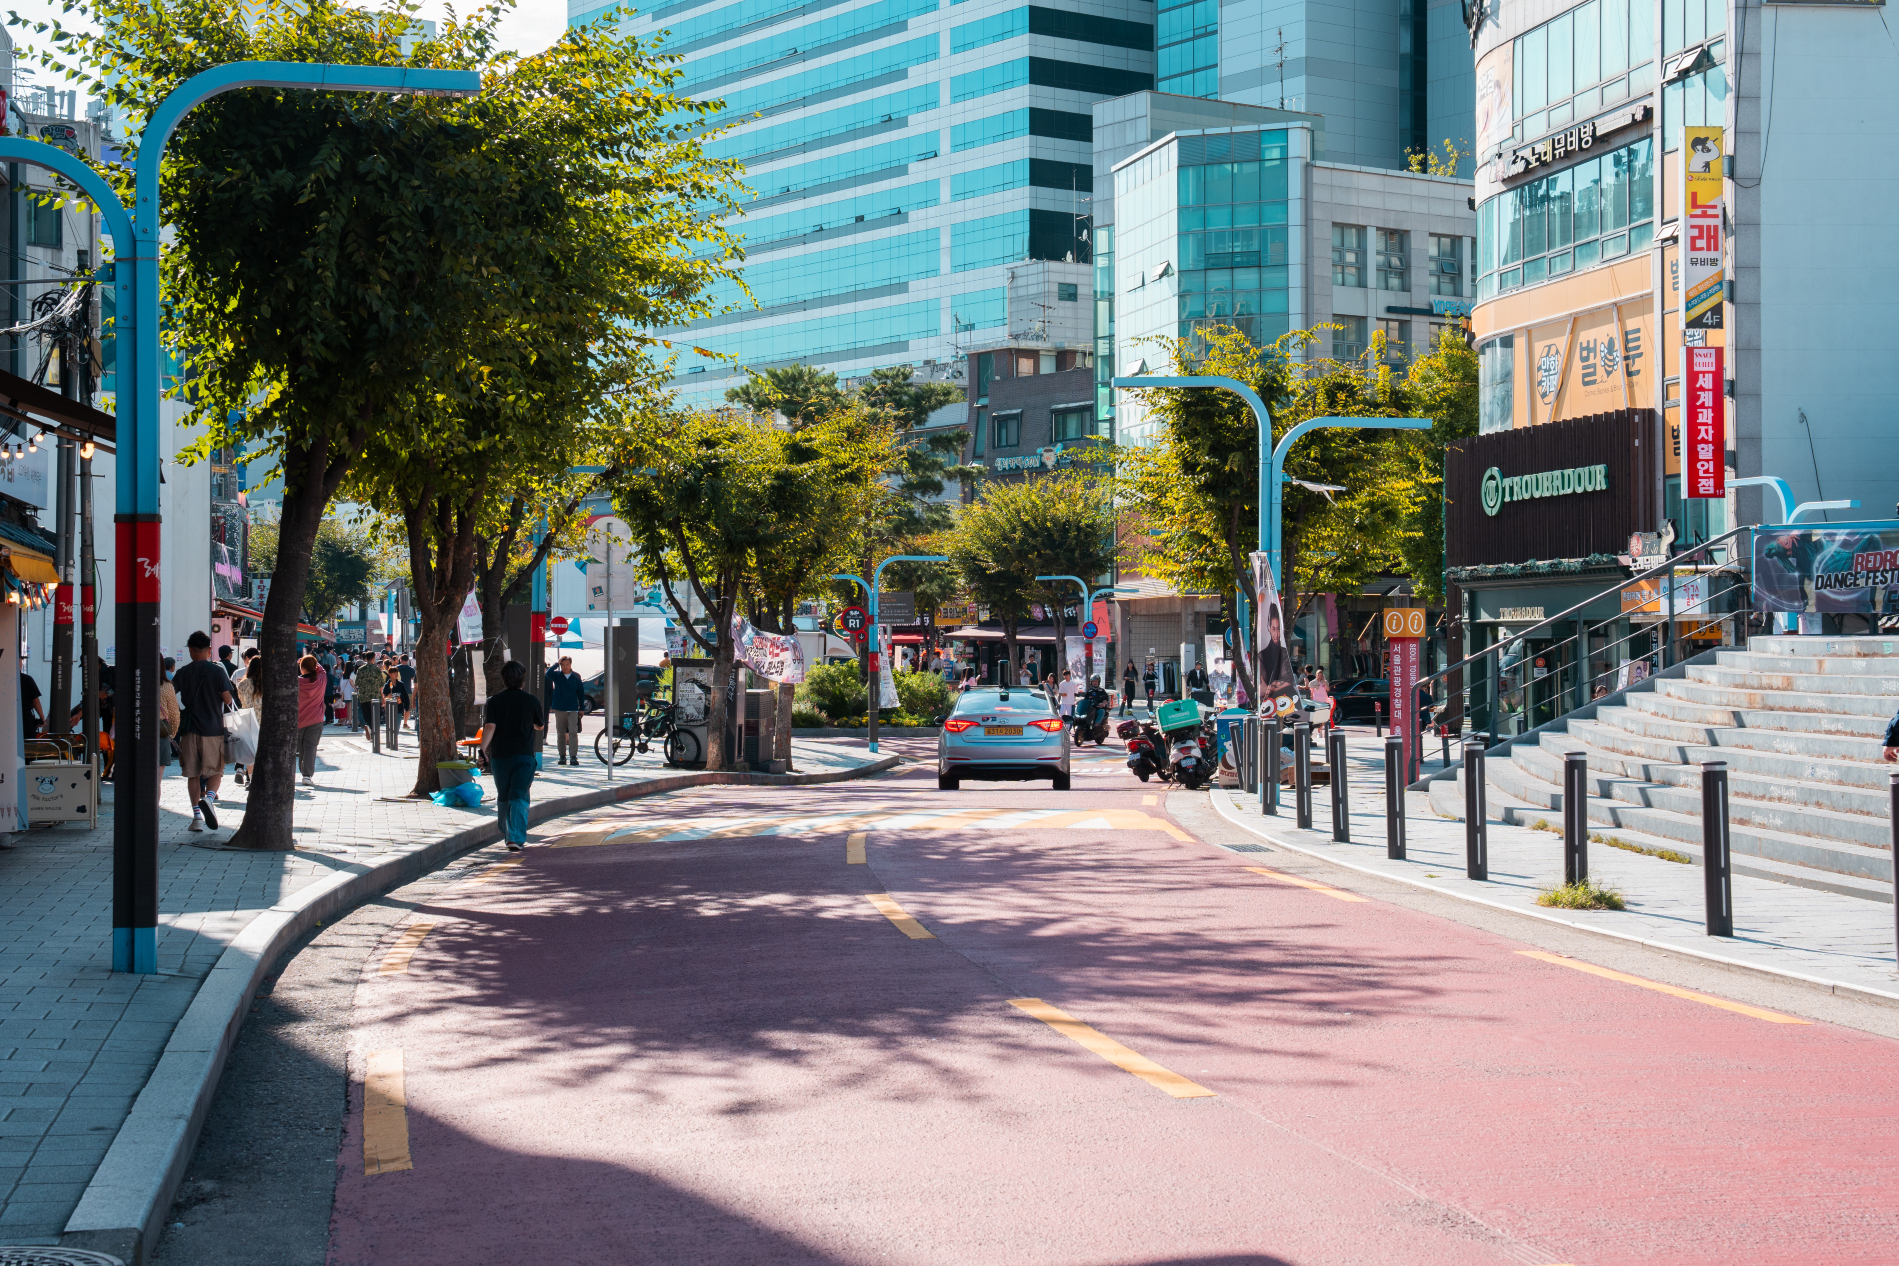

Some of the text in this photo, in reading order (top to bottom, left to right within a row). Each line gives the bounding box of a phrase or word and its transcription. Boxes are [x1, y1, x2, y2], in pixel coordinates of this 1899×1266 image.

[1689, 191, 1720, 252] 노래
[1690, 257, 1719, 267] 뮤비방
[1702, 311, 1721, 325] 4F
[1541, 353, 1559, 376] 만화
[1695, 373, 1714, 495] 세계과자할인점
[1503, 464, 1609, 502] TROUBADOUR
[1814, 571, 1861, 591] DANCE
[1683, 585, 1699, 607] 칼국수
[849, 619, 860, 628] R1
[1499, 607, 1545, 620] TROUBADOUR
[1409, 643, 1417, 663] SEOUL
[1393, 644, 1403, 720] 서울관광경찰대
[41, 793, 64, 802] factory
